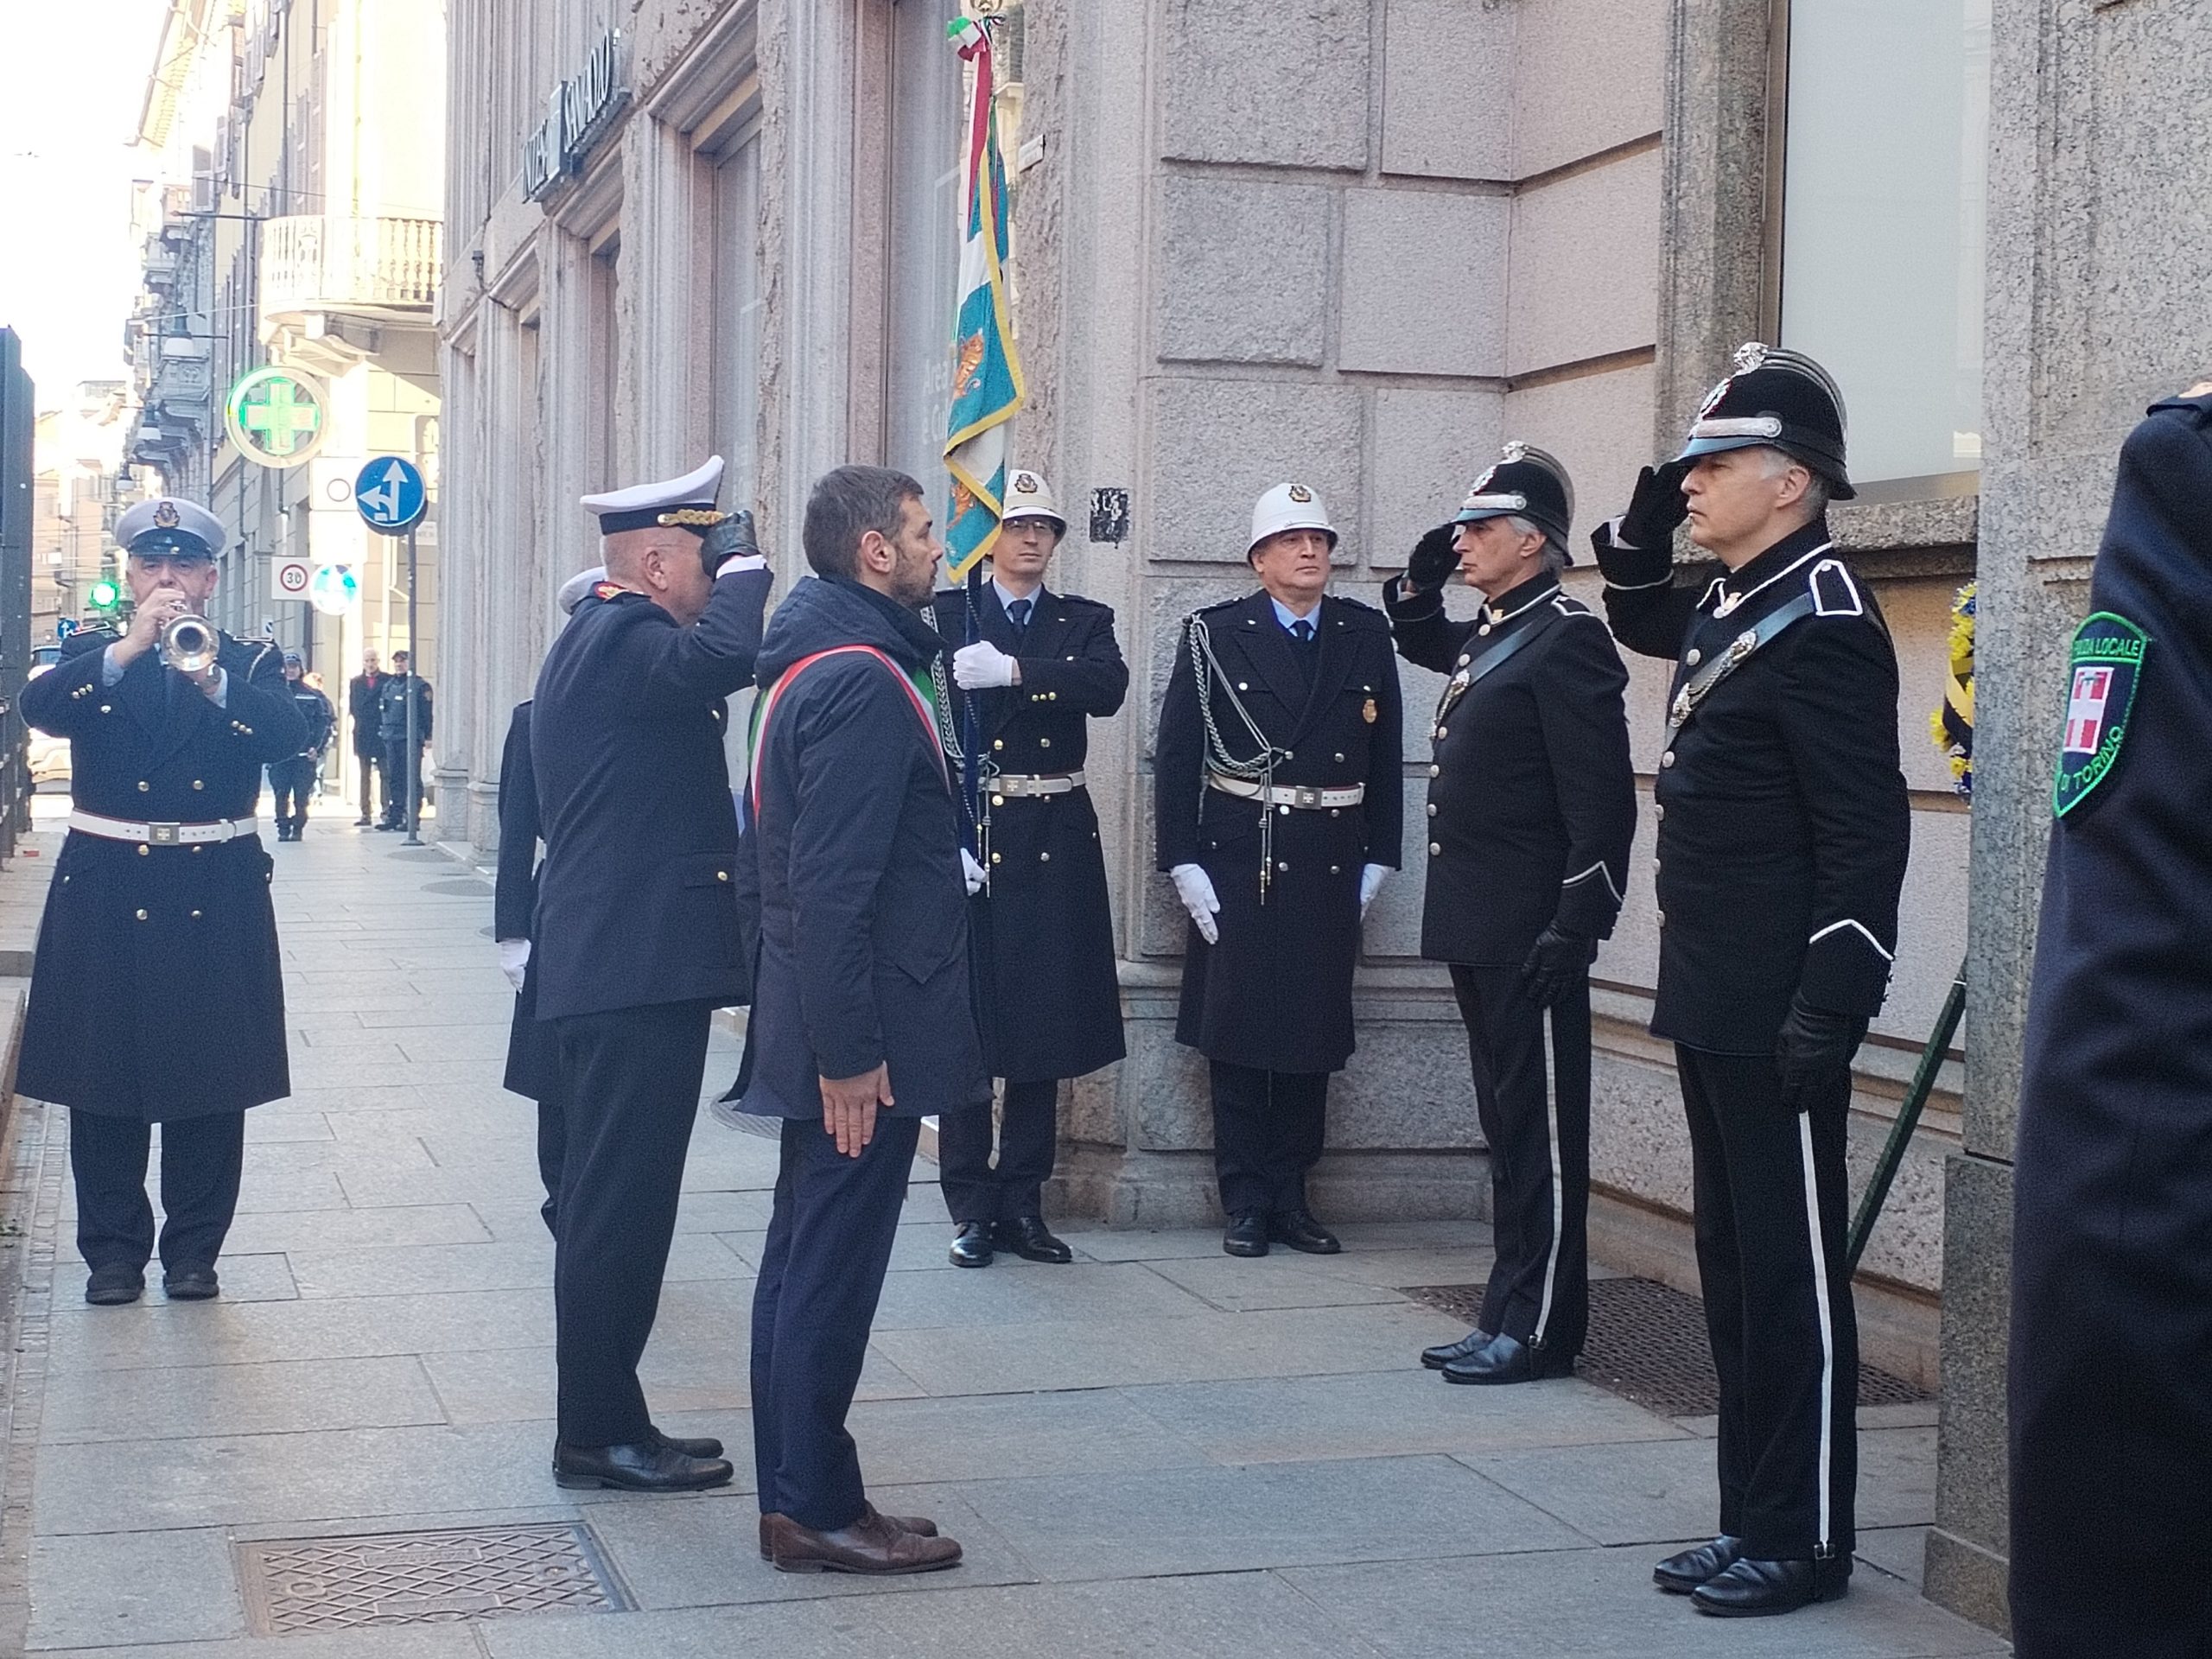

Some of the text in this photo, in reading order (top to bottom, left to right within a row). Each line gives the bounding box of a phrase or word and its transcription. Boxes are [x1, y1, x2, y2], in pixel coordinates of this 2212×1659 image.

[287, 572, 302, 584] 30
[2094, 638, 2140, 656] LOCALE
[2073, 727, 2123, 789] TORINO
